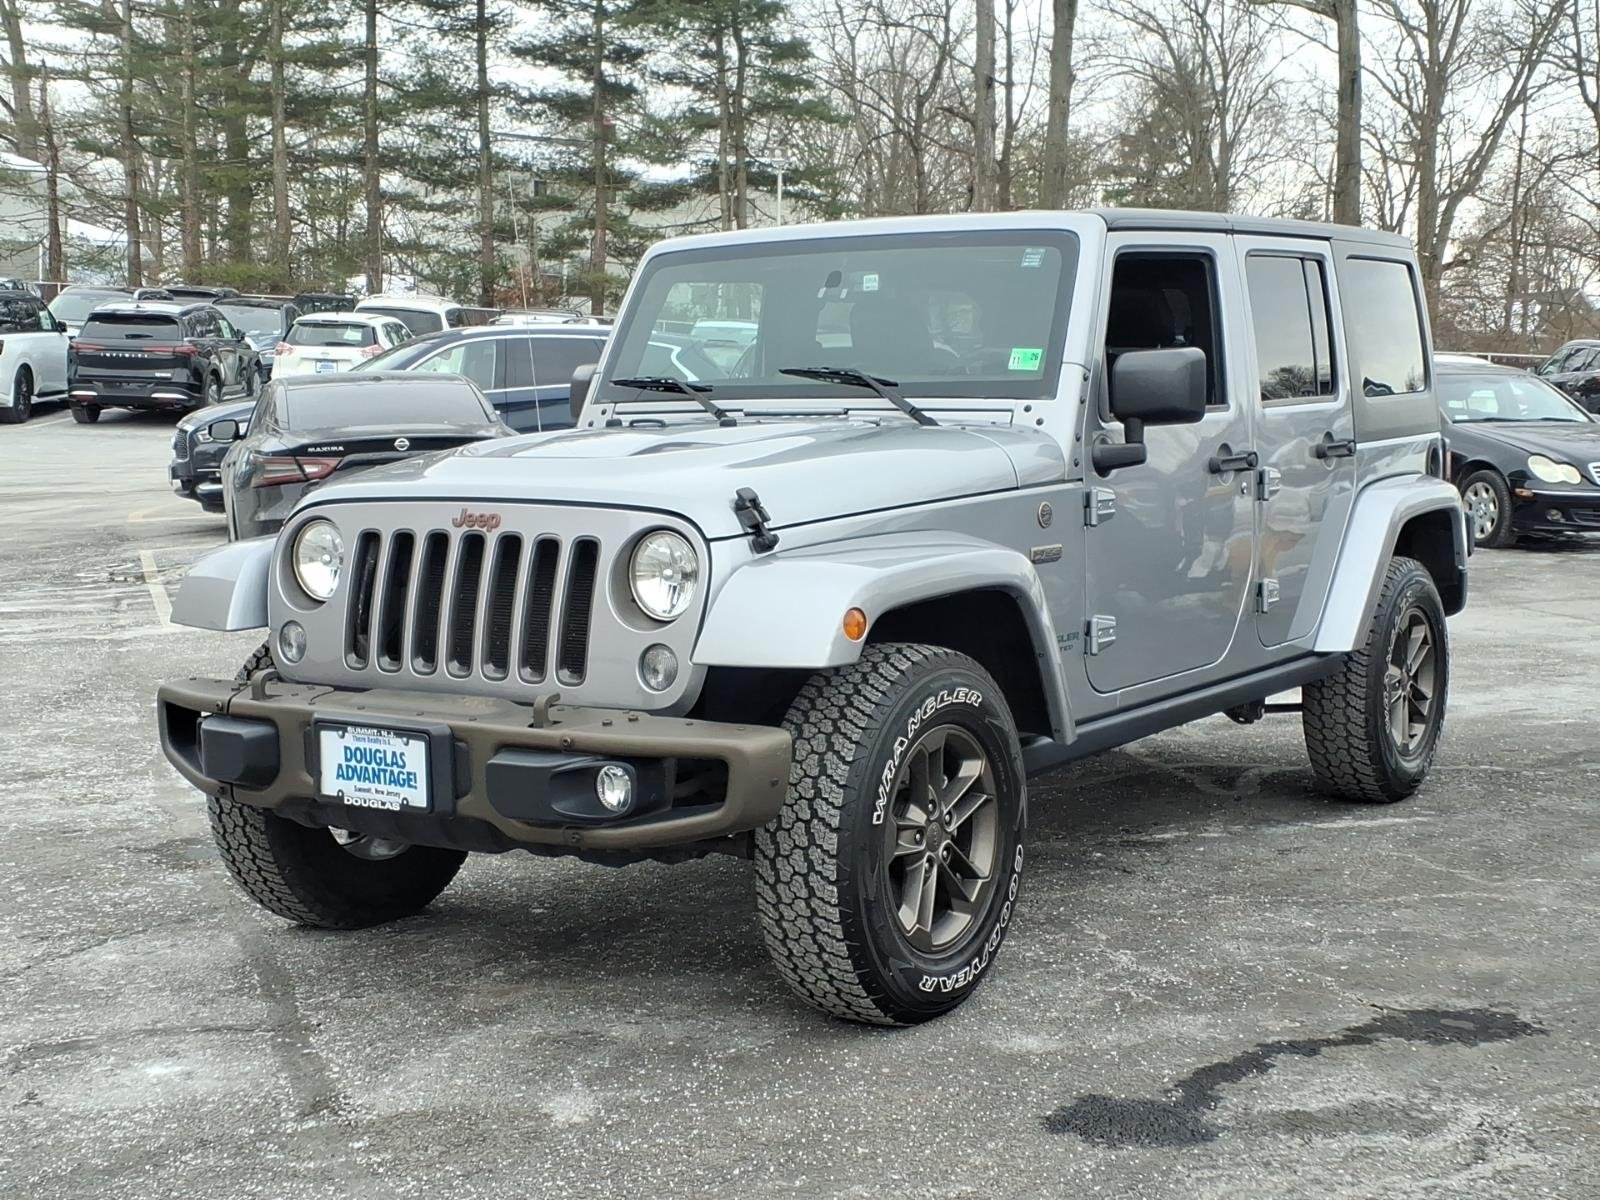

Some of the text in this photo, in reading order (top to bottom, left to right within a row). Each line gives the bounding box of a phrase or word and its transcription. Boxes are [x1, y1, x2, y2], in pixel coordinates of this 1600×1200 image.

[451, 507, 502, 533] Jeep
[344, 745, 406, 769] DOUGLAS
[872, 687, 982, 824] WRANGLER
[336, 763, 417, 790] ADVANTAGE!
[343, 796, 401, 811] DOUGLAS
[374, 787, 385, 796] New
[386, 789, 401, 799] Jersey
[919, 844, 1023, 992] GOODYEAR
